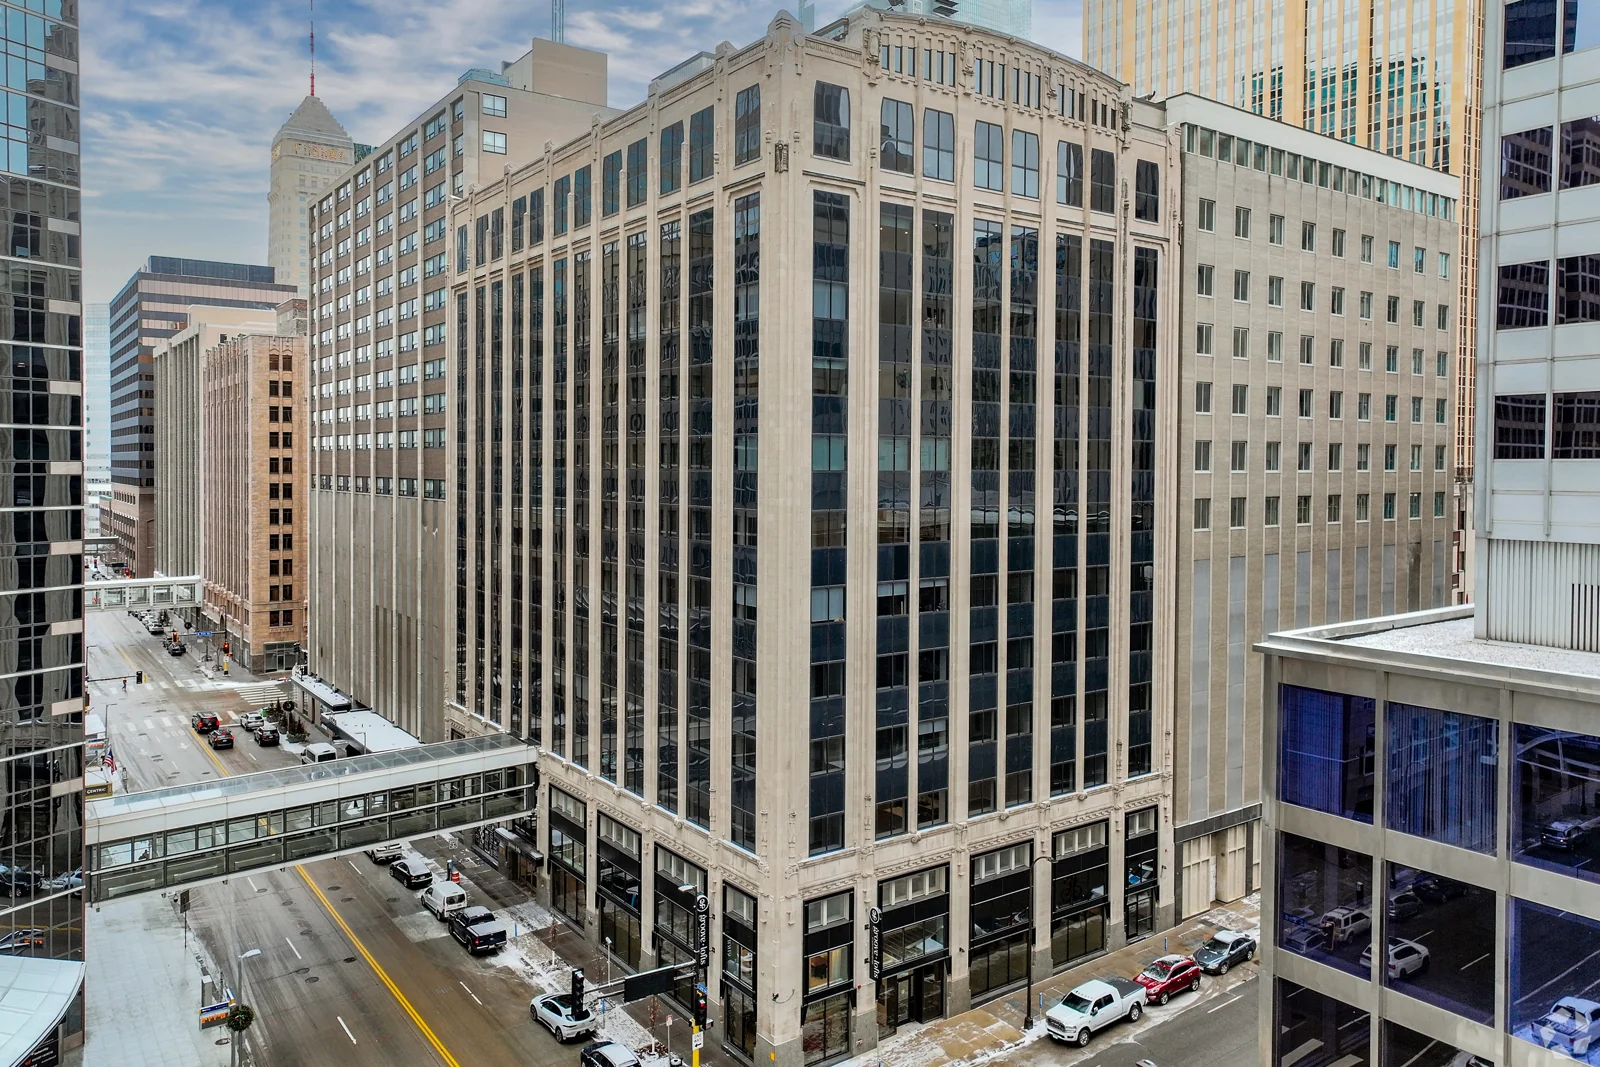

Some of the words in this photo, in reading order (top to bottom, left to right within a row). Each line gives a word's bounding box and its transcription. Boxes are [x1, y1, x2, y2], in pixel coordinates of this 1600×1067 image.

[86, 787, 106, 795] CENTRIC
[698, 914, 708, 943] groove
[872, 925, 880, 956] groove
[699, 946, 708, 966] lofts
[873, 959, 881, 979] lofts
